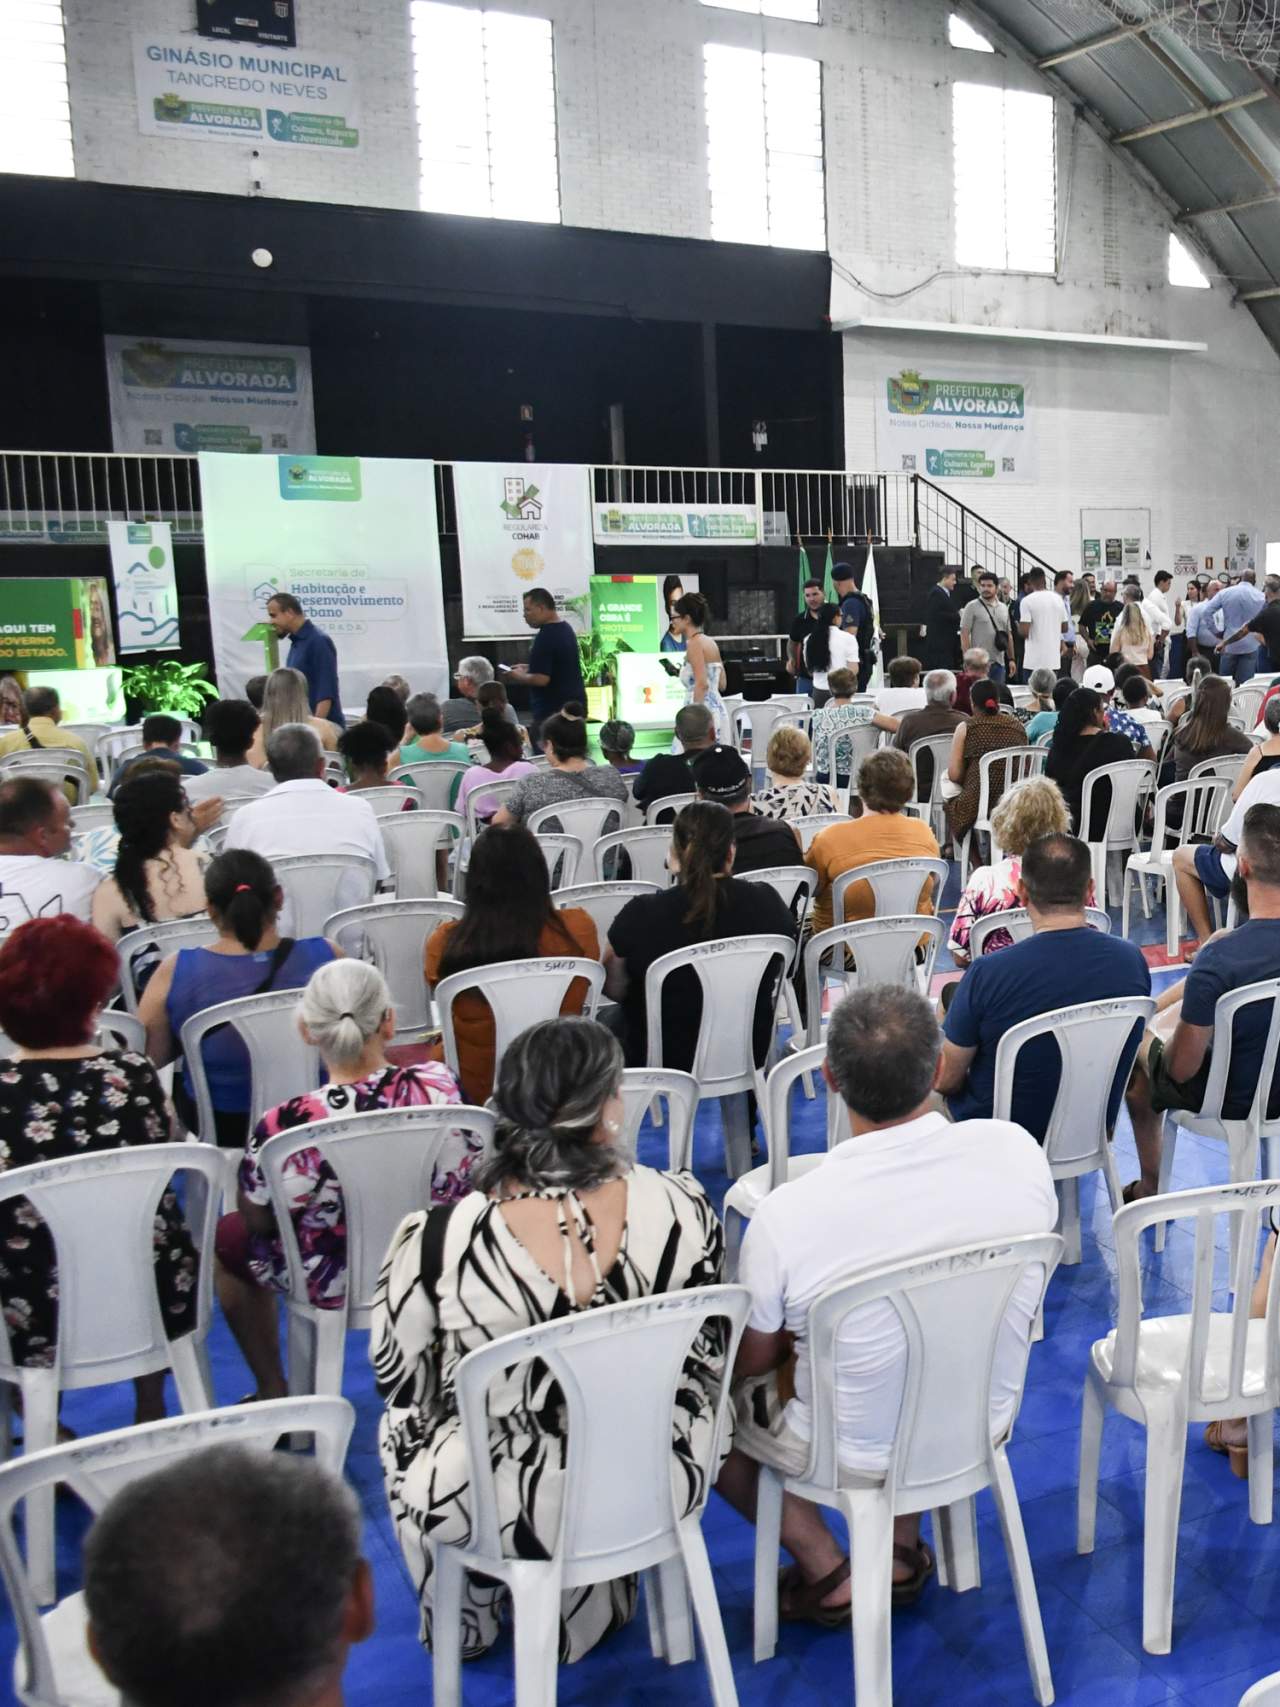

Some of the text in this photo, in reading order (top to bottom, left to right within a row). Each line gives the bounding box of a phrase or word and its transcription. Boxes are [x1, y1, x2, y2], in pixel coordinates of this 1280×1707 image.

[147, 45, 347, 82] GINÁSIO MUNICIPAL
[167, 70, 328, 100] TANCREDO NEVES
[190, 113, 260, 129] ALVORADA
[181, 370, 291, 389] ALVORADA
[935, 384, 1018, 400] PREFEITURA DE
[933, 397, 1020, 415] ALVORADA
[955, 421, 982, 430] Nossa
[984, 422, 1024, 432] Mudança
[628, 522, 682, 531] ALVORADA
[511, 532, 540, 540] COHAB
[289, 568, 366, 577] Secretaria de
[291, 583, 366, 596] Habitação e
[302, 607, 343, 617] rbano
[599, 603, 643, 613] A GRANDE
[600, 613, 623, 622] OBRA
[29, 624, 56, 633] TEM
